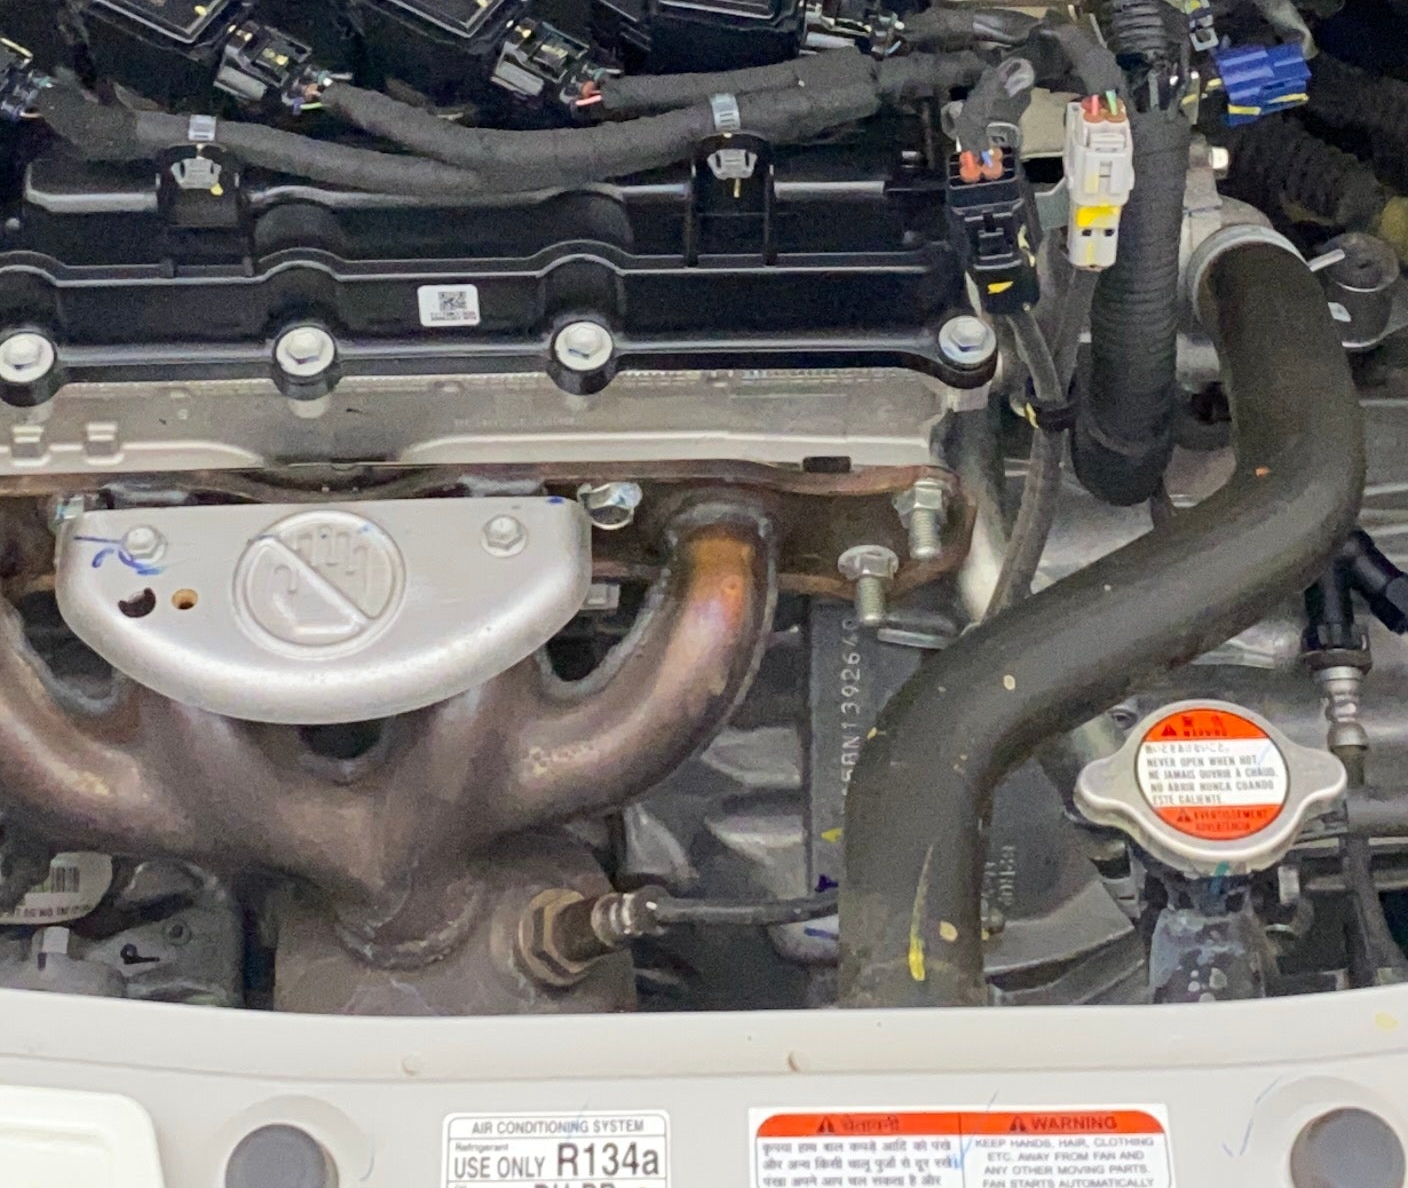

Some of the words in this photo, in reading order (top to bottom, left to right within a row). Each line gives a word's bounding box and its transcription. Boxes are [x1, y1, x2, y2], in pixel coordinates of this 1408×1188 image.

[1147, 757, 1176, 767] NEVER
[1180, 756, 1204, 766] OPEN
[1208, 755, 1235, 765] WHEN
[1148, 770, 1159, 779] NE
[1164, 769, 1196, 779] JAMAIS
[1150, 782, 1163, 792] NO
[1168, 782, 1195, 792] ABRIR
[1199, 781, 1232, 791] NUNCA
[1235, 779, 1274, 790] CUANDO
[472, 1121, 493, 1134] AIR
[497, 1120, 589, 1134] CONDITIONING
[593, 1119, 644, 1132] SYSTEM
[1030, 1116, 1118, 1130] WARNING
[455, 1142, 509, 1154] Refrigerant
[976, 1139, 1006, 1147] KEEP
[1094, 1137, 1155, 1147] CLOTHING
[454, 1157, 491, 1179] USE
[497, 1156, 545, 1178] ONLY
[556, 1141, 659, 1177] R134a
[1018, 1152, 1050, 1161] AWAY
[1054, 1152, 1089, 1161] FROM
[1093, 1151, 1116, 1160] FAN
[1120, 1150, 1145, 1160] AND
[984, 1166, 1007, 1175] ANY
[1012, 1166, 1053, 1175] OTHER
[1057, 1166, 1105, 1175] MOVING
[982, 1180, 1006, 1188] FAN
[1010, 1180, 1055, 1188] STARTS
[1059, 1178, 1154, 1188] AUTOMATICALLY
